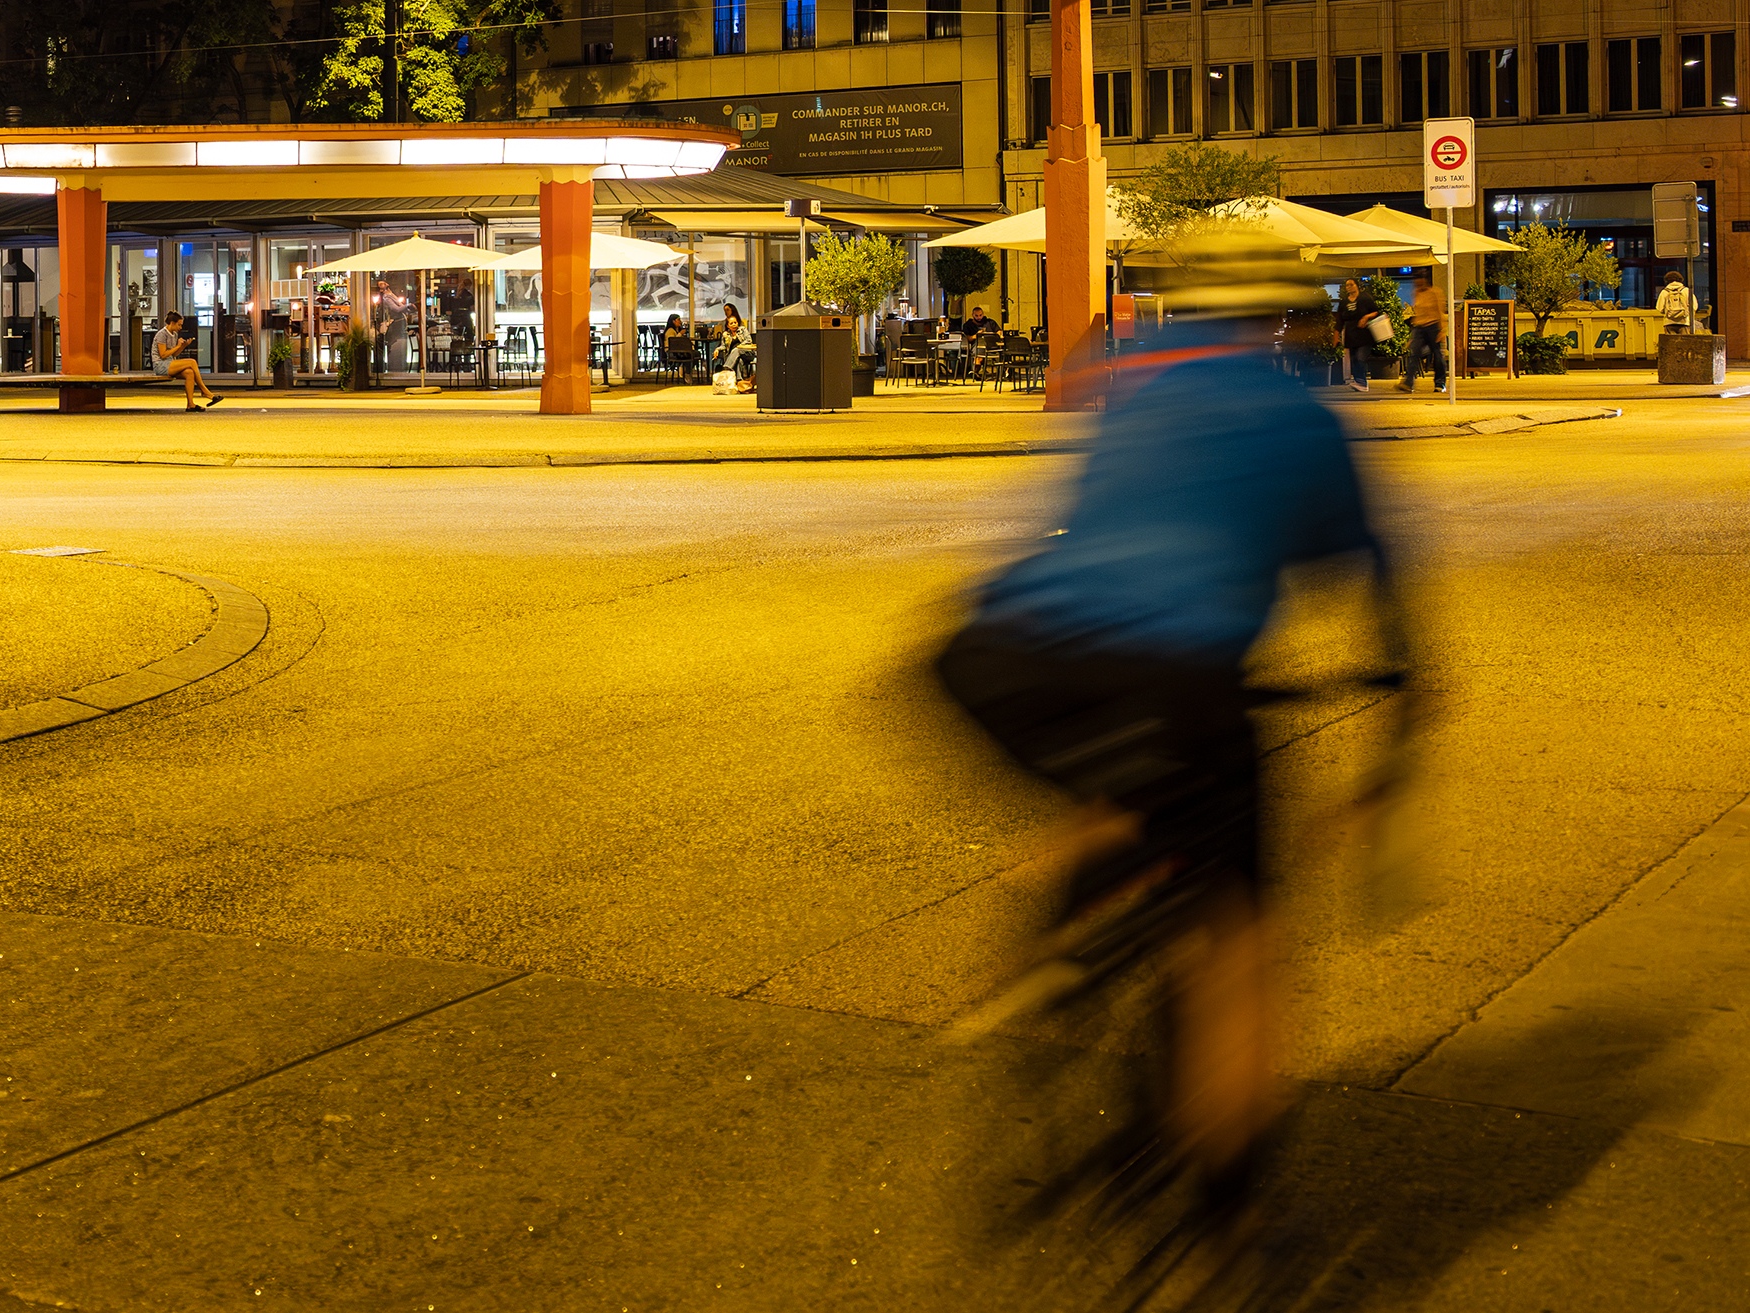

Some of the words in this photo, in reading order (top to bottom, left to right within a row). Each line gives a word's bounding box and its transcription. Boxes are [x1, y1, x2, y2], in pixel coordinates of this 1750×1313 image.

[792, 106, 860, 119] COMMANDER
[863, 105, 884, 115] SUR
[887, 101, 950, 114] MANOR.CH,
[840, 117, 882, 128] RETIRER
[885, 116, 900, 126] EN
[808, 131, 857, 142] MAGASIN
[860, 130, 873, 140] 1H
[876, 128, 902, 139] PLUS
[904, 127, 933, 138] TARD
[745, 140, 770, 148] Collect
[725, 156, 768, 166] MANOR
[1434, 175, 1447, 183] BUS
[1450, 174, 1465, 182] TAXI
[1470, 307, 1497, 316] TAPAS
